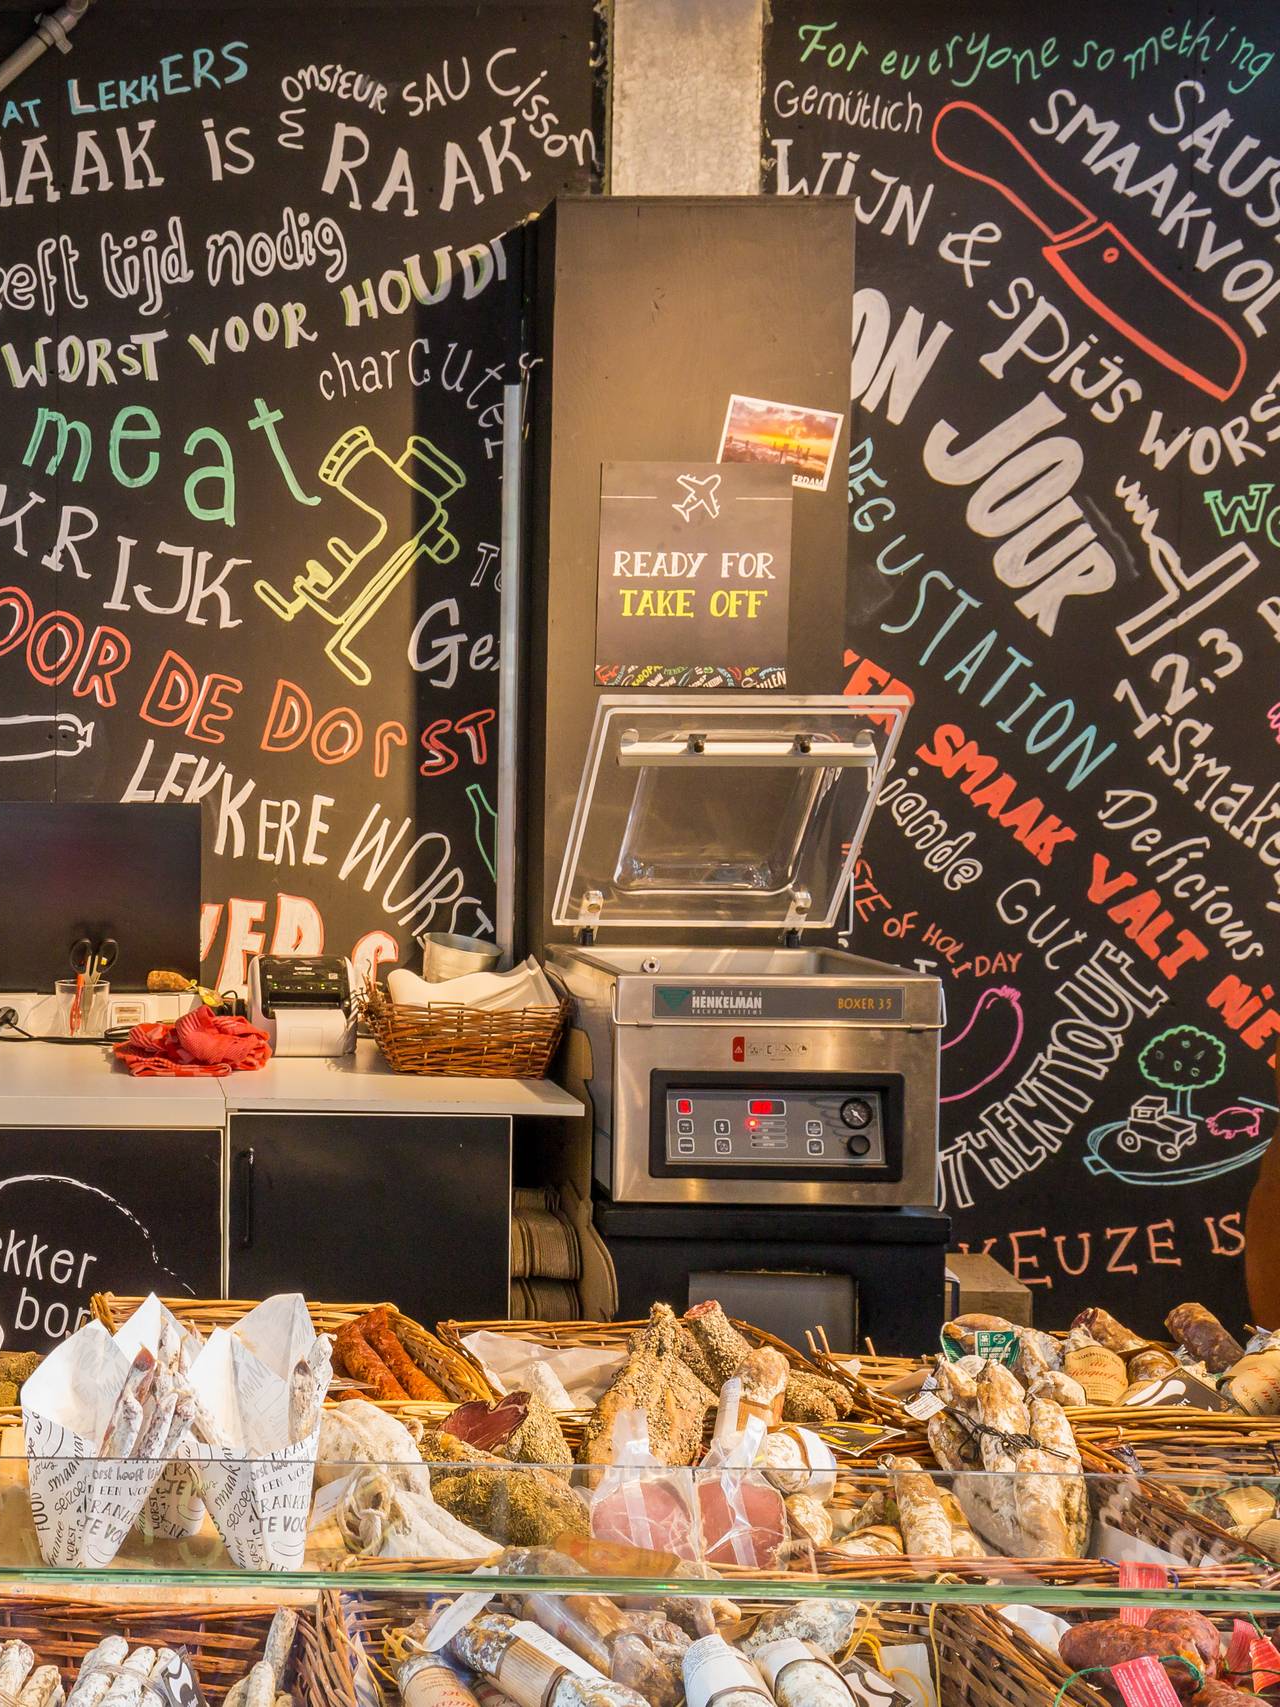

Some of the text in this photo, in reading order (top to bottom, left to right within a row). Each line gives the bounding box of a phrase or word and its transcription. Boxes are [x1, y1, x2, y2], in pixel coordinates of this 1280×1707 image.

[798, 16, 1276, 94] For everyone something
[774, 79, 923, 135] Gemütlich
[321, 116, 532, 217] RAAK
[101, 216, 194, 316] tijd
[206, 206, 349, 286] nodig
[0, 329, 168, 389] WORST
[187, 301, 318, 366] VOOR
[22, 397, 322, 527] meat
[923, 391, 1117, 637] JOUR
[613, 551, 776, 580] READY FOR
[619, 588, 769, 619] TAKE OFF
[139, 649, 244, 744] DE
[120, 738, 336, 867] LEKKERE
[915, 723, 1211, 981] SMAAK VALT
[1097, 789, 1266, 961] Delicious
[882, 910, 919, 939] OF
[691, 995, 763, 1010] HENKELMAN
[837, 998, 894, 1011] BOXER 35
[1205, 1212, 1247, 1258] IS
